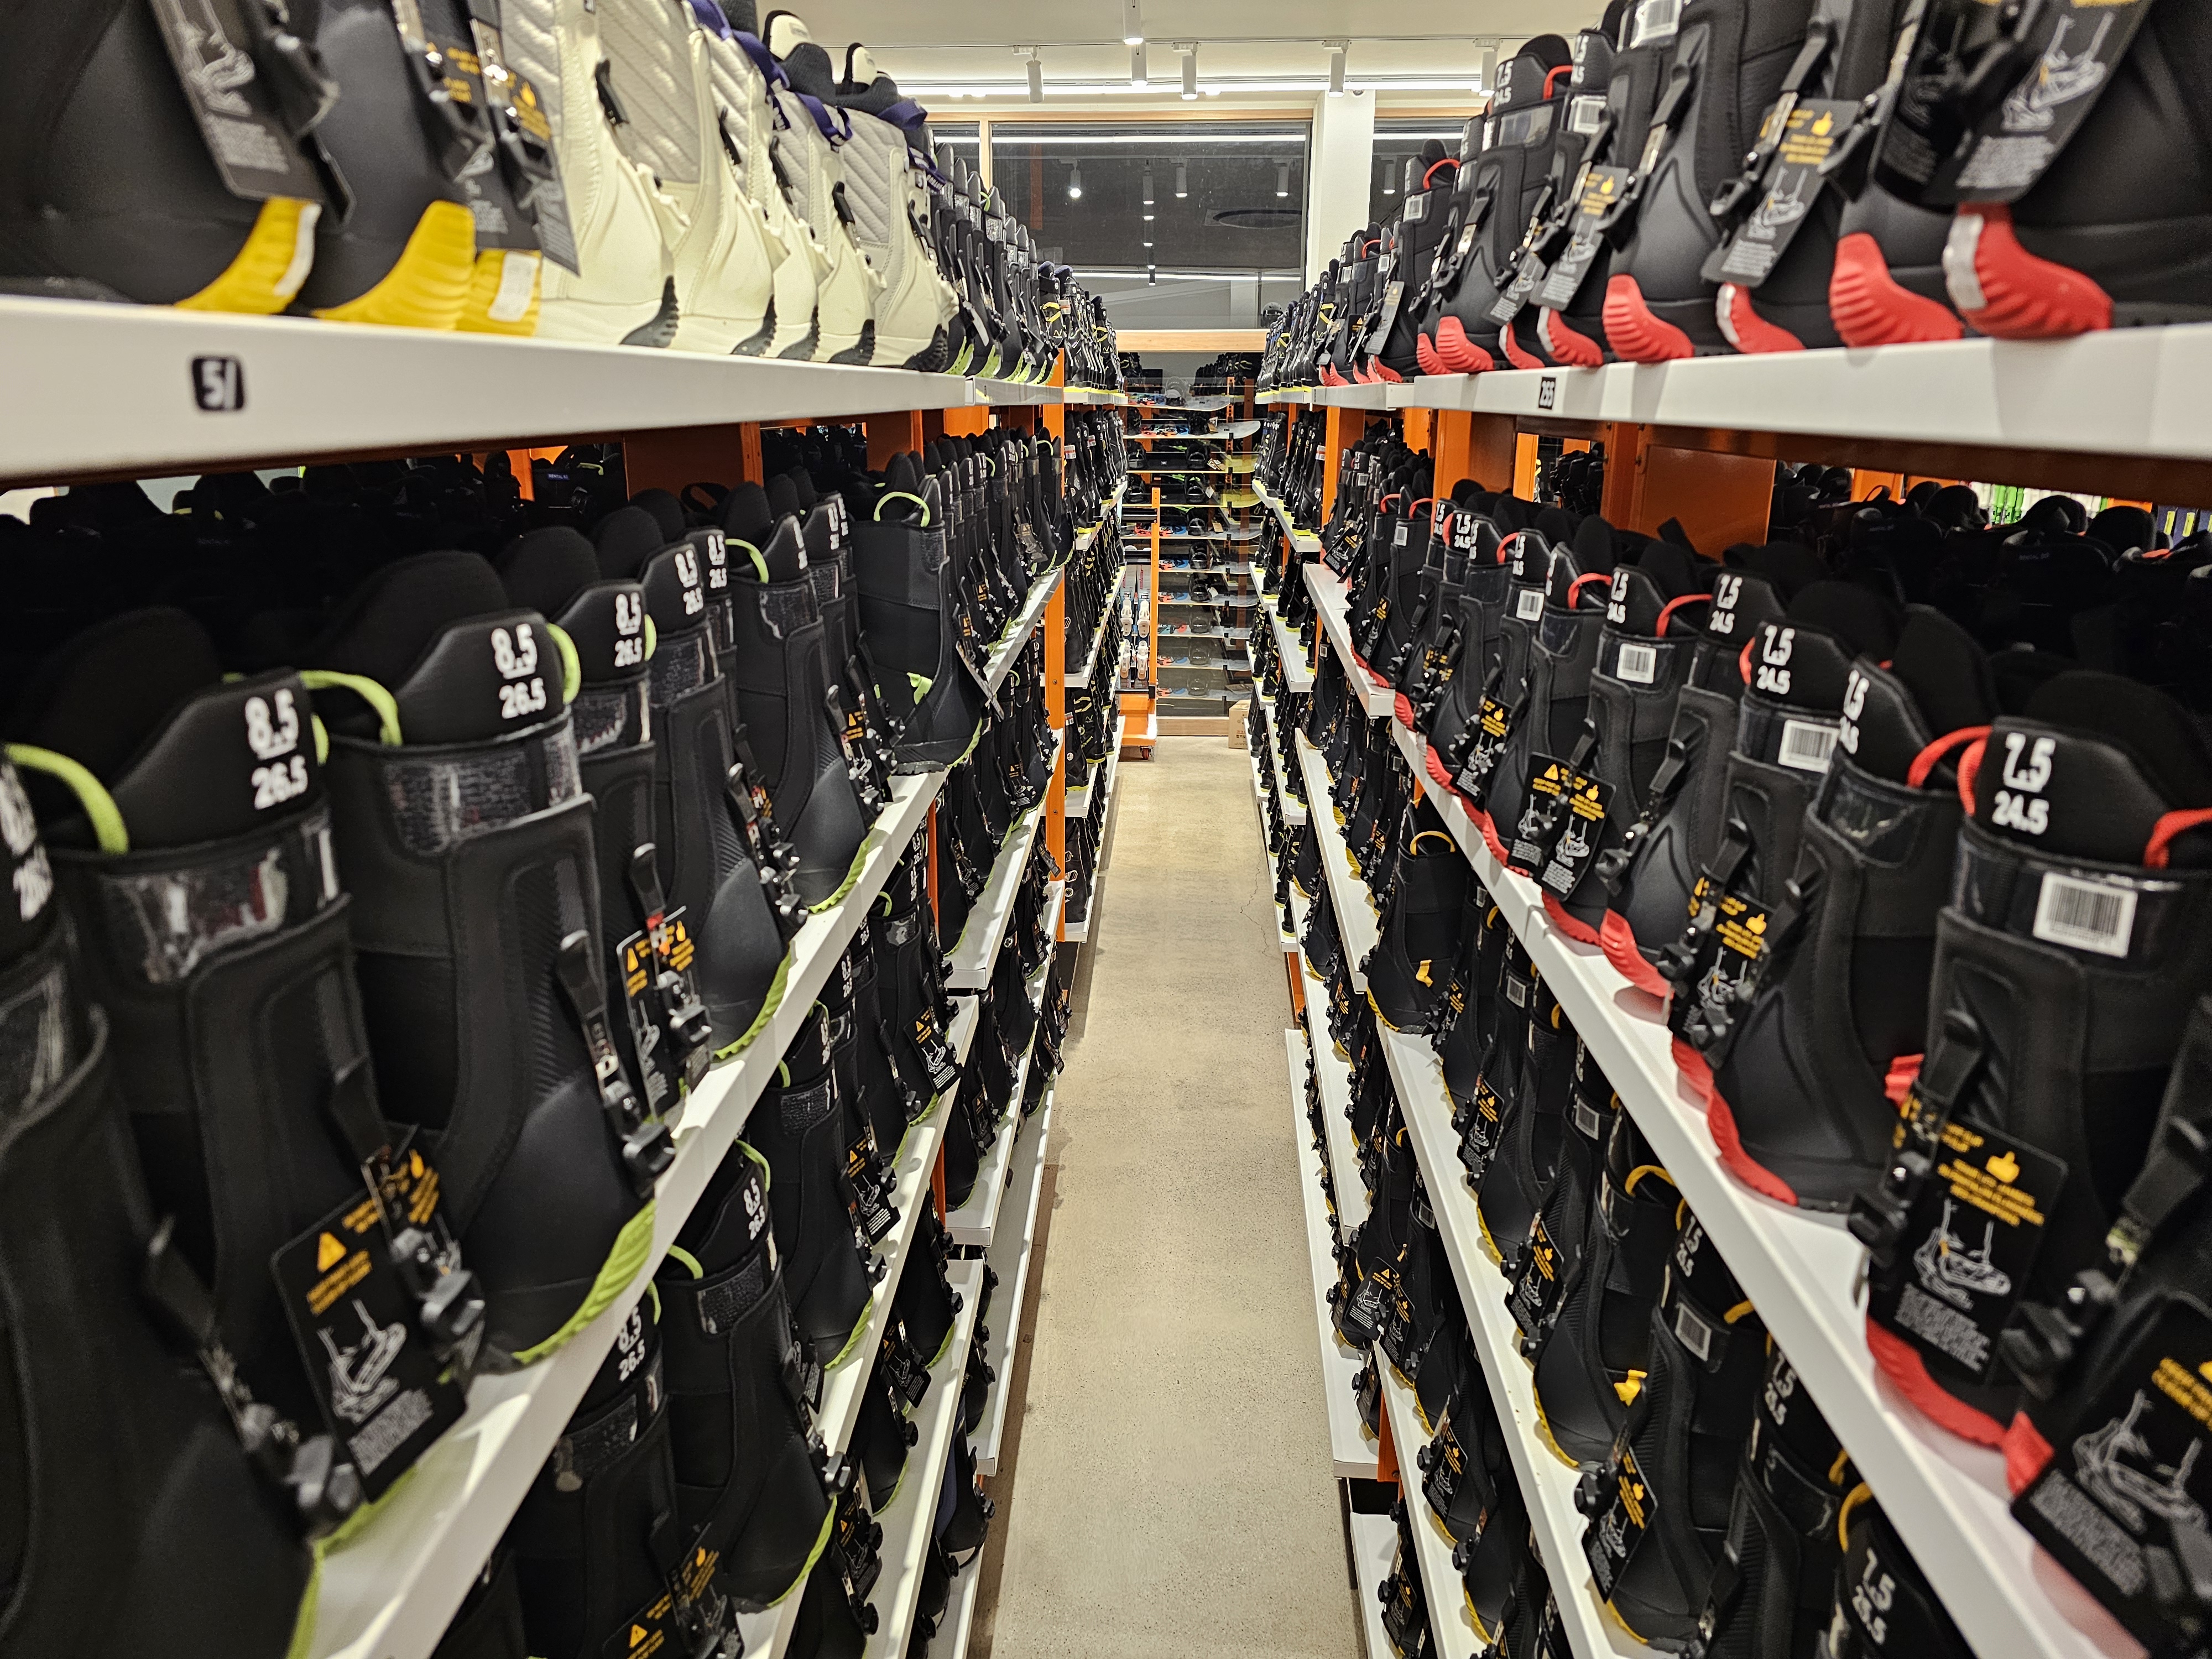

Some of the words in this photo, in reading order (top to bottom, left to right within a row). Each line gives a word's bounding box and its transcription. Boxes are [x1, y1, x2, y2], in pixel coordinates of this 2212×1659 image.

[1496, 60, 1514, 88] 7.5
[1454, 535, 1471, 549] 24.5
[1455, 513, 1471, 534] 7.5
[675, 550, 698, 588] 8.5
[707, 535, 726, 566] 8.5
[709, 567, 727, 589] 26.5
[1611, 571, 1629, 602] 7.5
[1717, 575, 1743, 609] 7.5
[615, 593, 642, 635] 8.5
[683, 587, 704, 615] 26.5
[1709, 610, 1735, 634] 24.5
[490, 623, 538, 681] 8.5
[614, 637, 643, 668] 26.5
[1762, 625, 1795, 666] 7.5
[499, 679, 547, 720] 26.5
[1756, 665, 1791, 695] 24.5
[1843, 669, 1869, 721] 7.5
[245, 689, 299, 761] 8.5
[2002, 732, 2056, 794] 7.5
[251, 755, 309, 811] 26.5
[1992, 792, 2049, 835] 24.5
[841, 955, 851, 981] 8.5
[743, 1177, 761, 1216] 8.5
[748, 1205, 766, 1241] 26.5
[1684, 1214, 1703, 1254] 7.5
[618, 1304, 641, 1354] 8.5
[618, 1338, 645, 1383] 26.5
[1772, 1352, 1797, 1399] 7.5
[1863, 1547, 1896, 1612] 7.5
